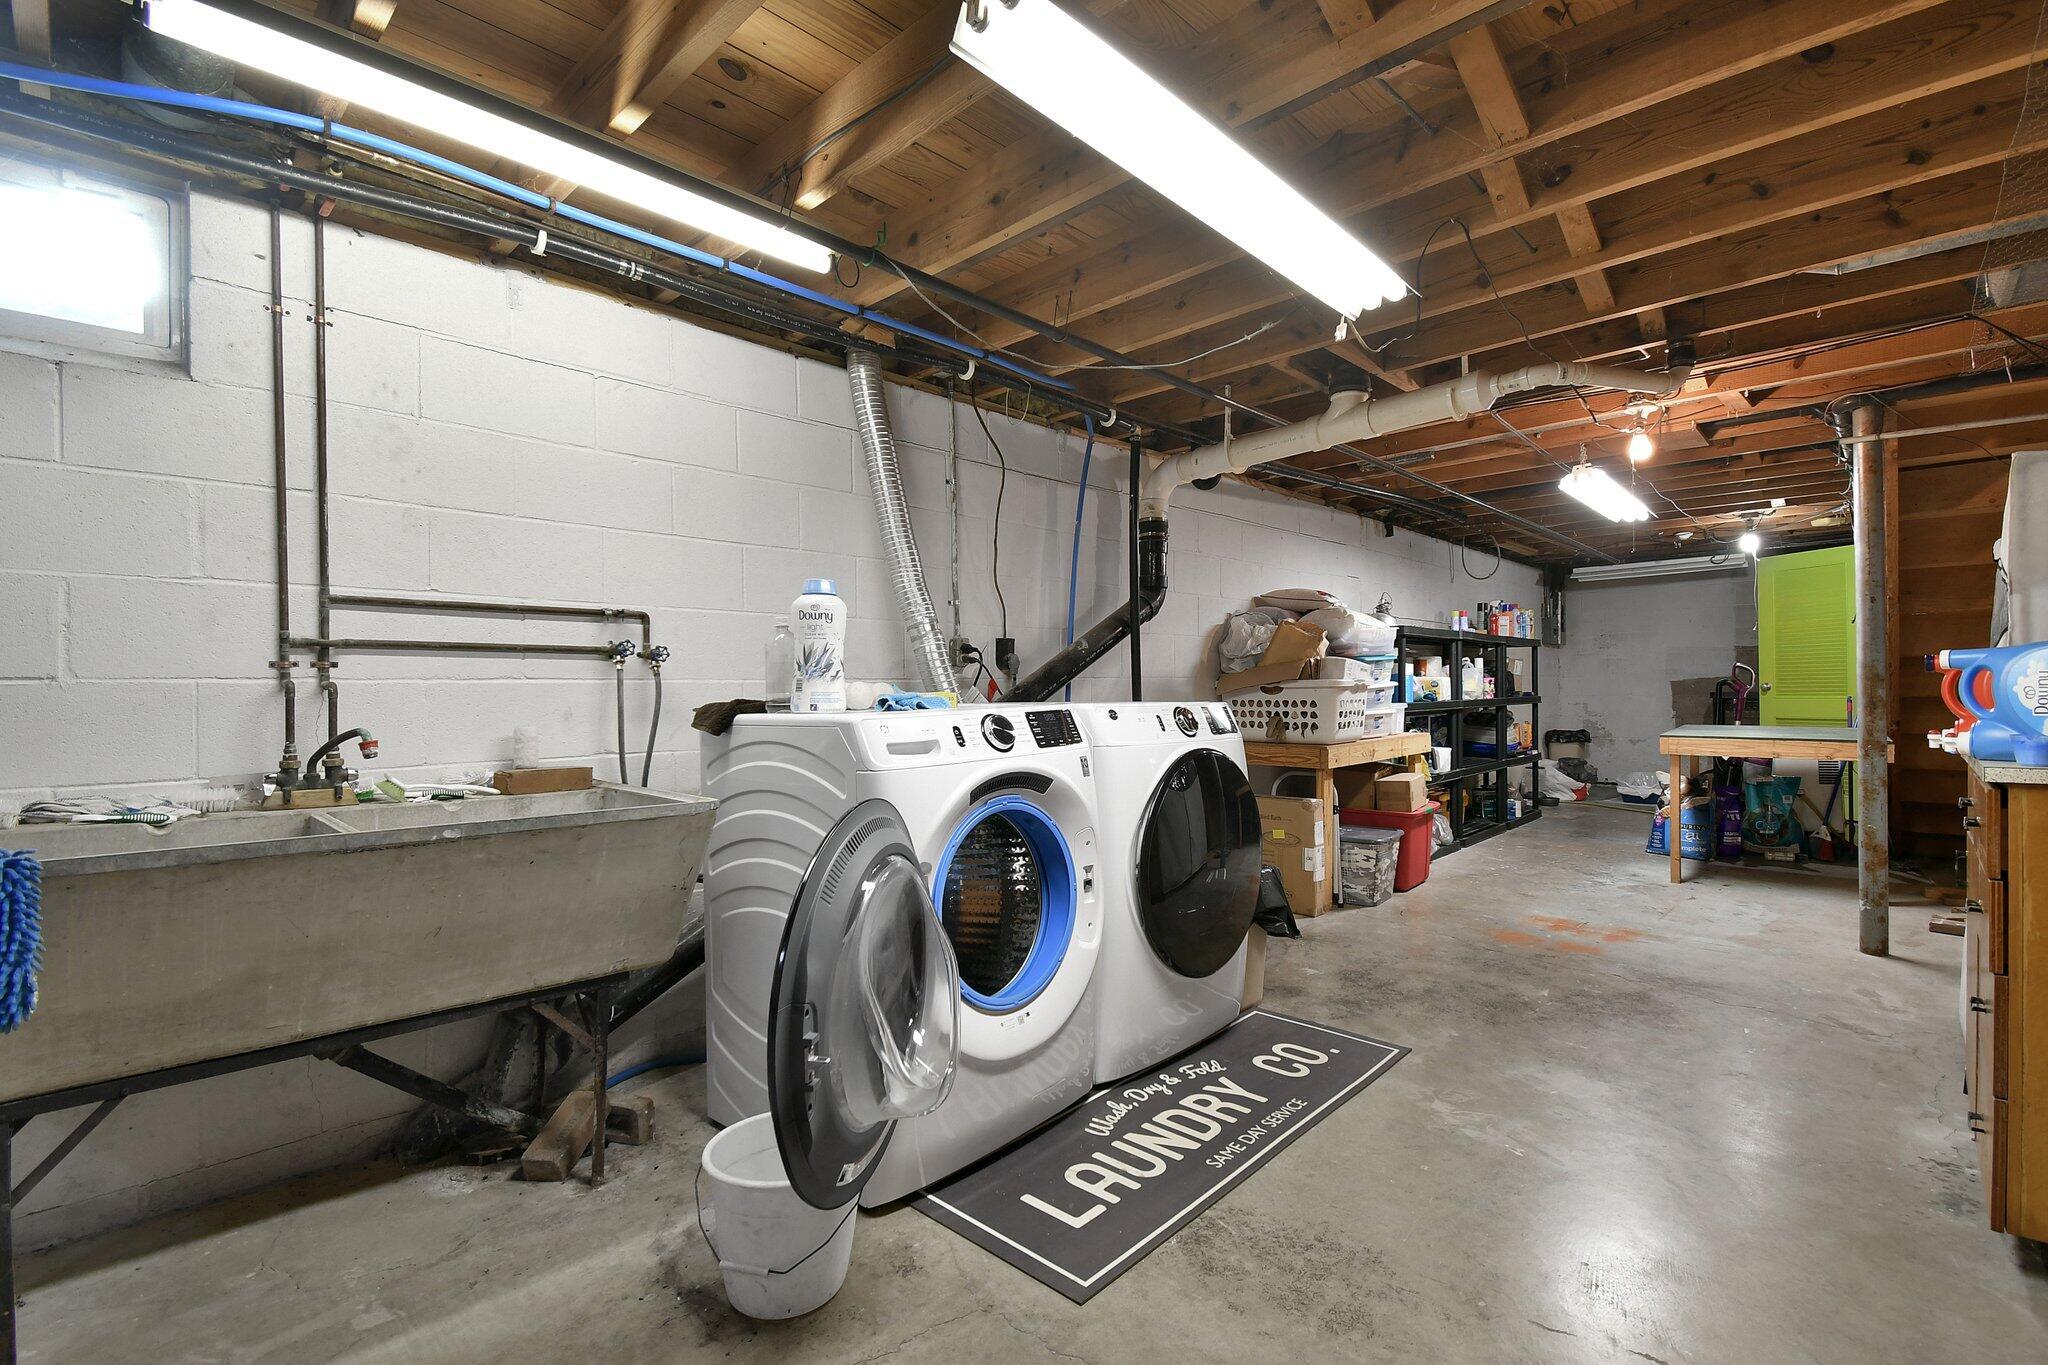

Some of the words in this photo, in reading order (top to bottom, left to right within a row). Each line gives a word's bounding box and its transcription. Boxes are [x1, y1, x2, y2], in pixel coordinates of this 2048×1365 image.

[798, 609, 834, 624] Downy
[1123, 1083, 1173, 1102] Dry
[1159, 1074, 1183, 1086] &
[1179, 1059, 1228, 1080] Fold
[1019, 1076, 1269, 1229] LAUNDRY
[1251, 1042, 1341, 1078] CO.
[1205, 1141, 1247, 1169] SAME
[1237, 1124, 1268, 1145] DAY
[1260, 1097, 1308, 1128] SERVICE
